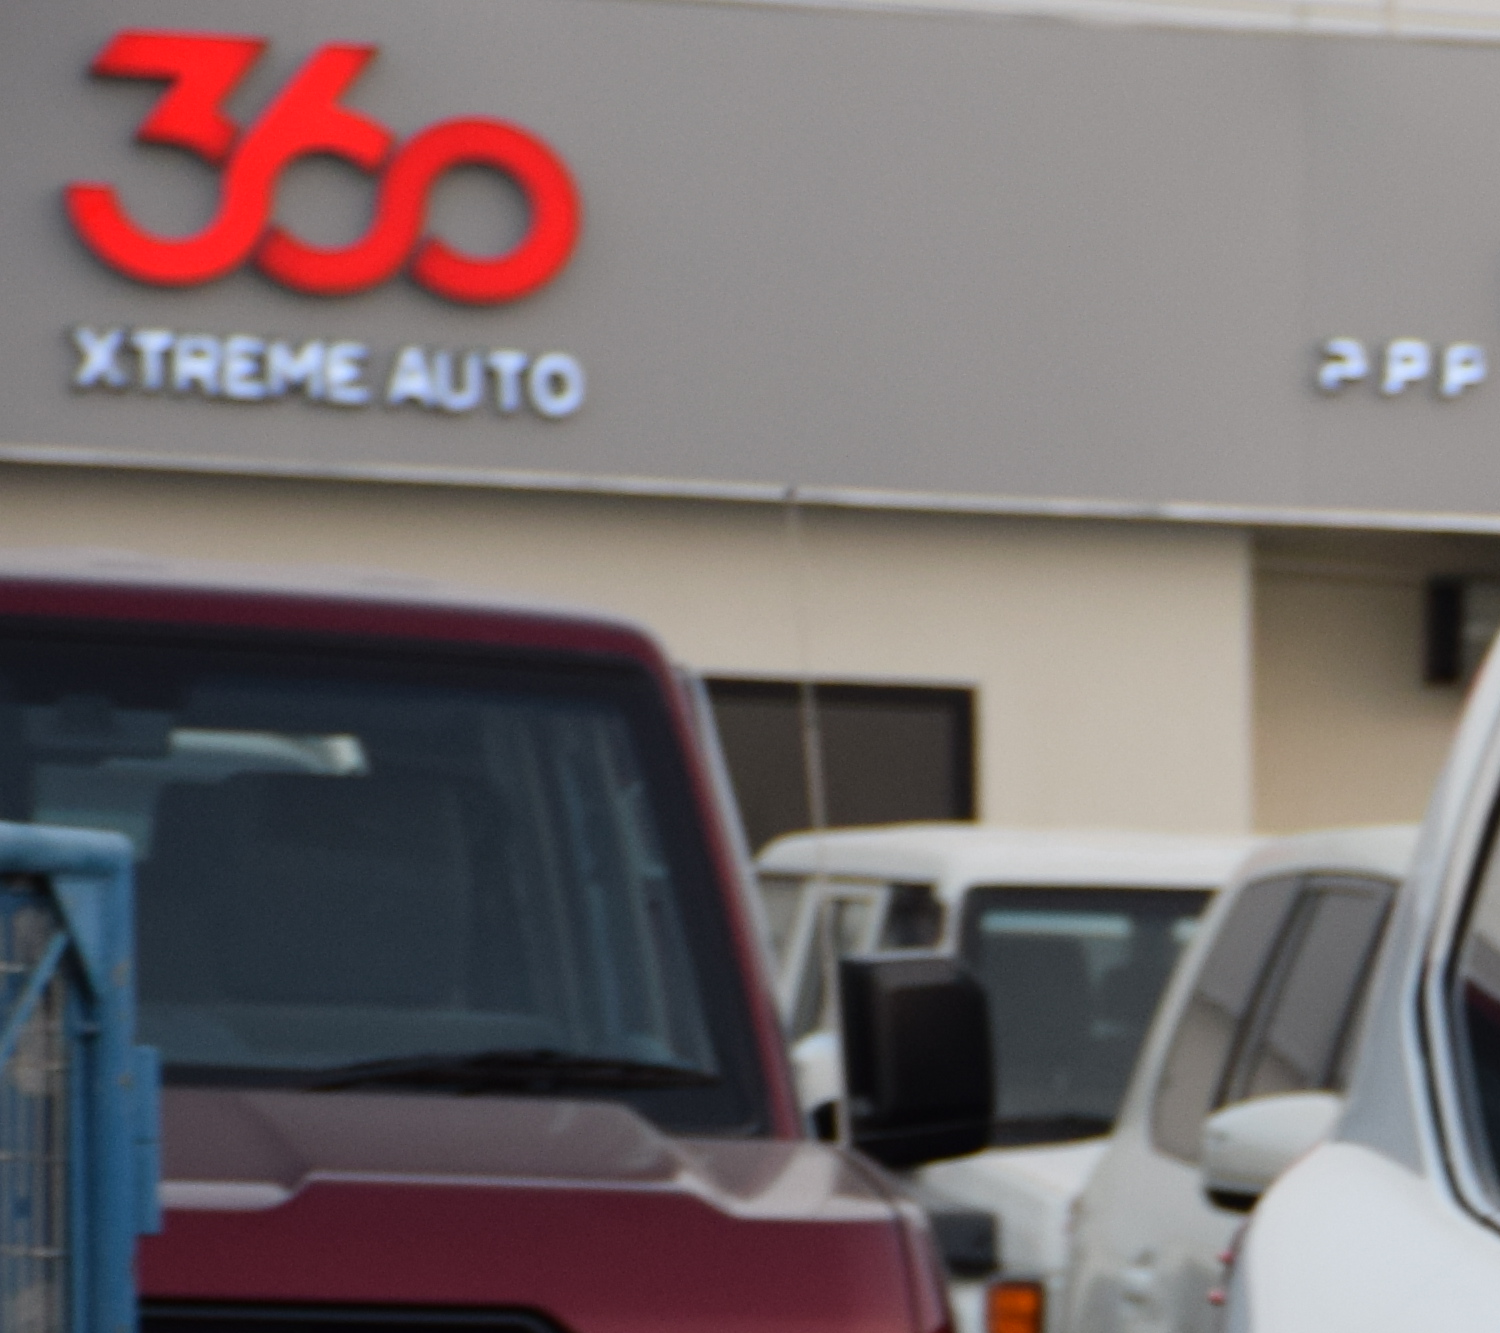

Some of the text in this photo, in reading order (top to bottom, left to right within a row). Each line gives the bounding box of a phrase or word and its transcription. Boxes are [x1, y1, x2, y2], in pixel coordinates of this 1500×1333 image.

[65, 28, 583, 304] 360
[73, 327, 585, 417] XTREME AUTO
